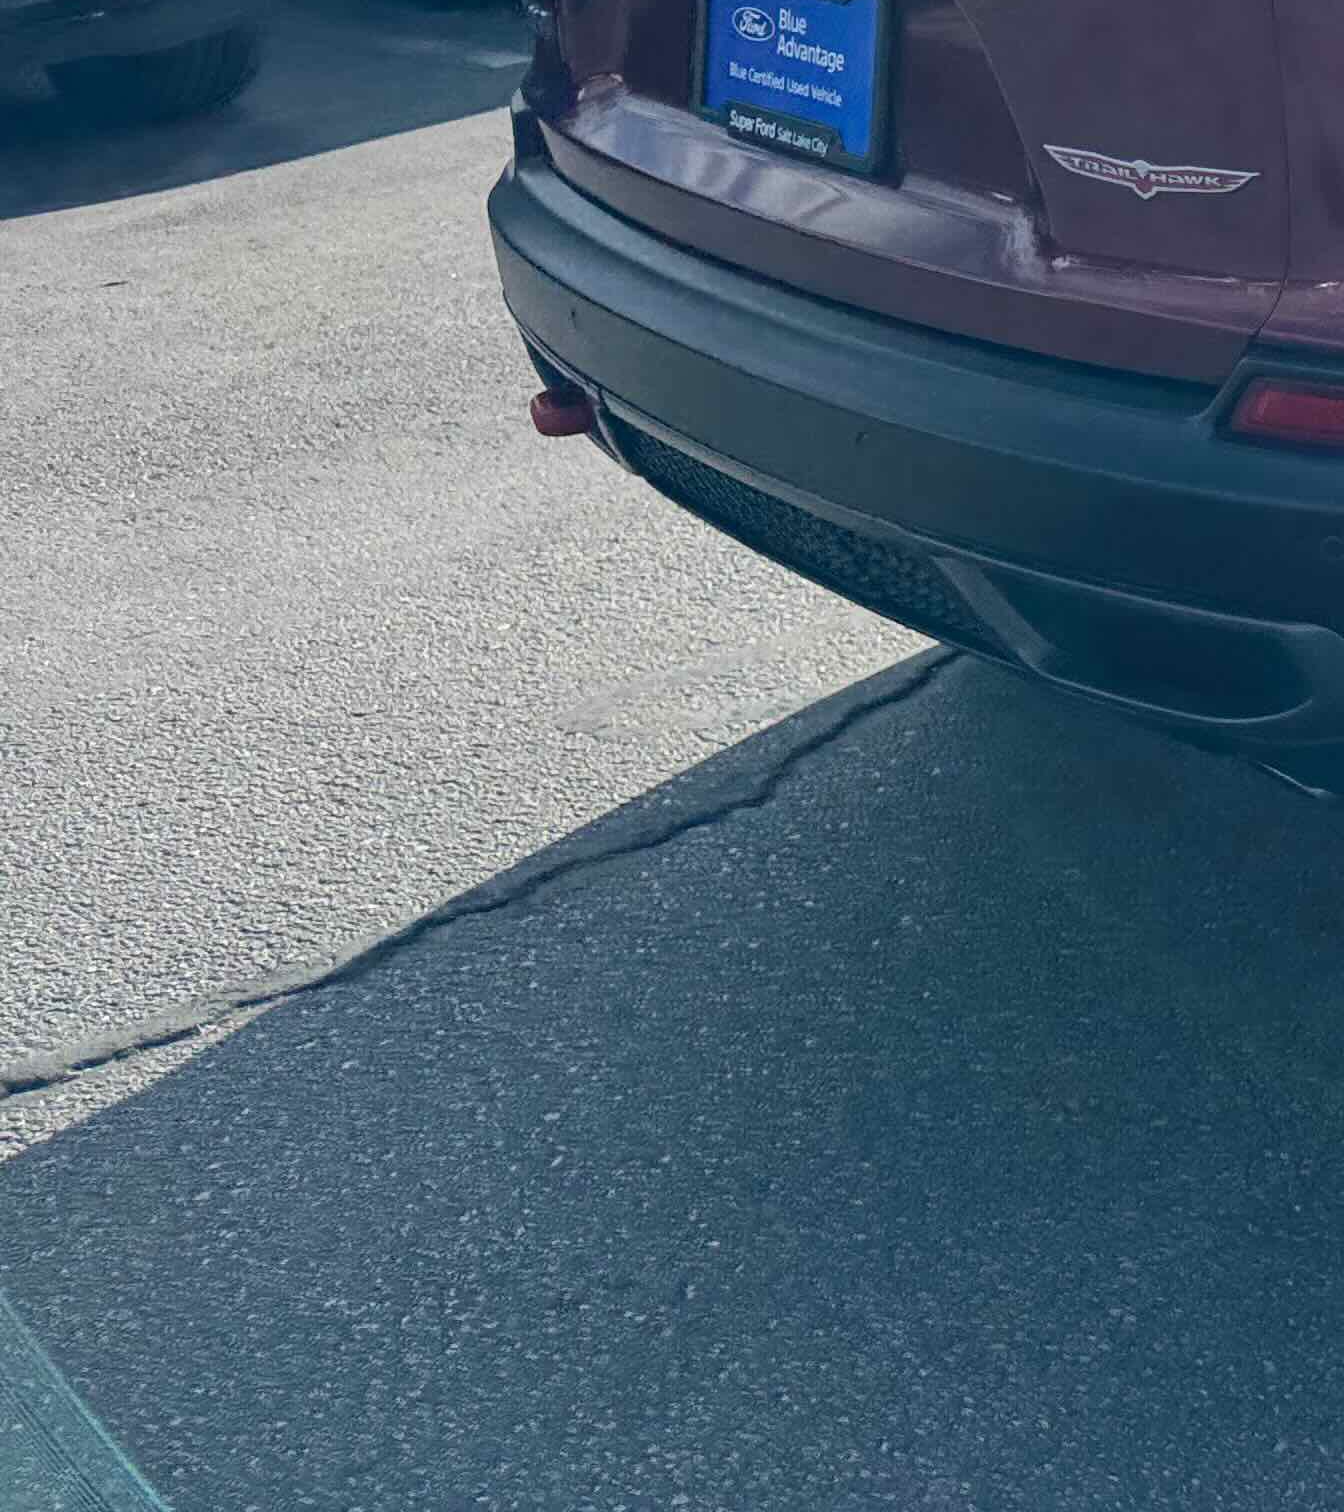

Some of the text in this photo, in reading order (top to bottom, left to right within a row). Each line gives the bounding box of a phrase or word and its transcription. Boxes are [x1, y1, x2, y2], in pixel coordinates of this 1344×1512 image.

[738, 8, 769, 37] Ford
[778, 7, 808, 35] Blue
[776, 34, 845, 73] Advantage
[729, 61, 843, 107] Blue Certified Used Vehicle
[729, 109, 829, 158] Super Ford Salt Lake City
[1069, 157, 1220, 186] TRAIL HAWK
